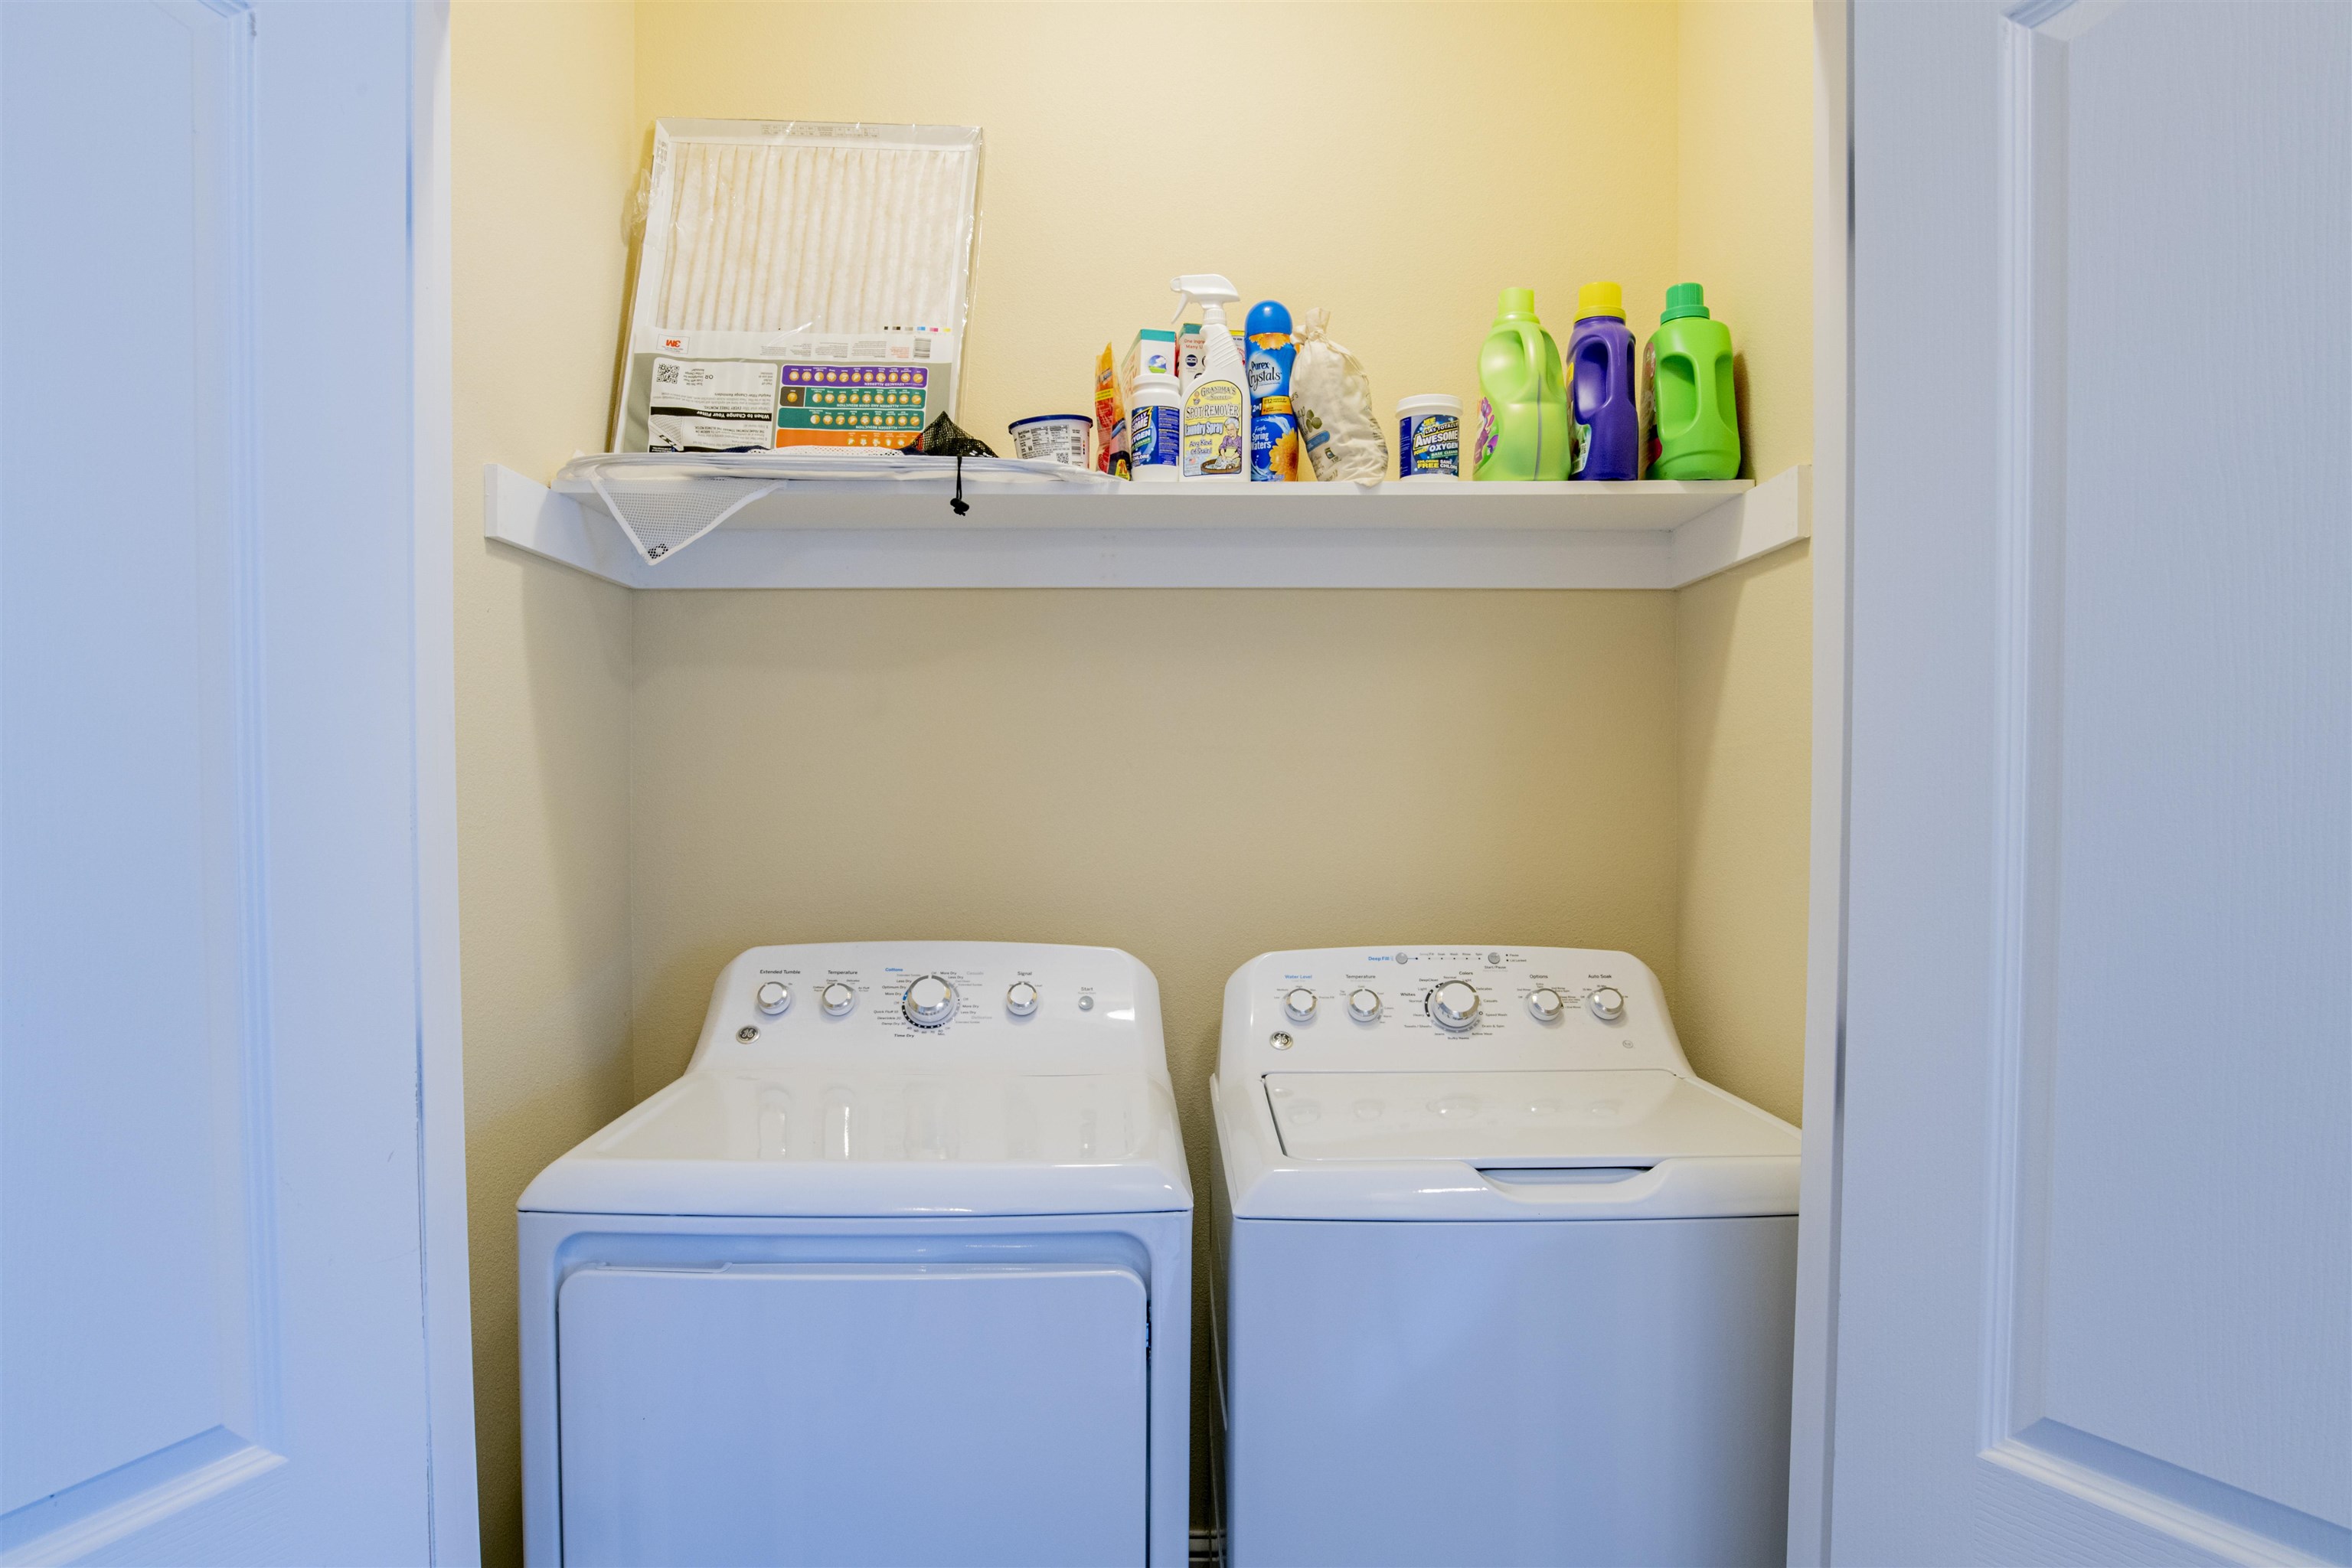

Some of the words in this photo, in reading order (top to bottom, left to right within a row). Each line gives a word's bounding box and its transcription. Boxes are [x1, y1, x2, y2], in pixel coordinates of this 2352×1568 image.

[666, 339, 681, 348] 3M
[1251, 361, 1269, 371] Purex
[1248, 367, 1280, 391] Crystals
[1187, 407, 1202, 418] SPOT
[1204, 404, 1239, 416] REMOVER
[1185, 422, 1205, 436] Laundry
[1207, 421, 1223, 435] Spray
[1253, 432, 1269, 442] Spring
[1415, 430, 1458, 447] AWESOME
[1429, 443, 1458, 452] OXYGEN
